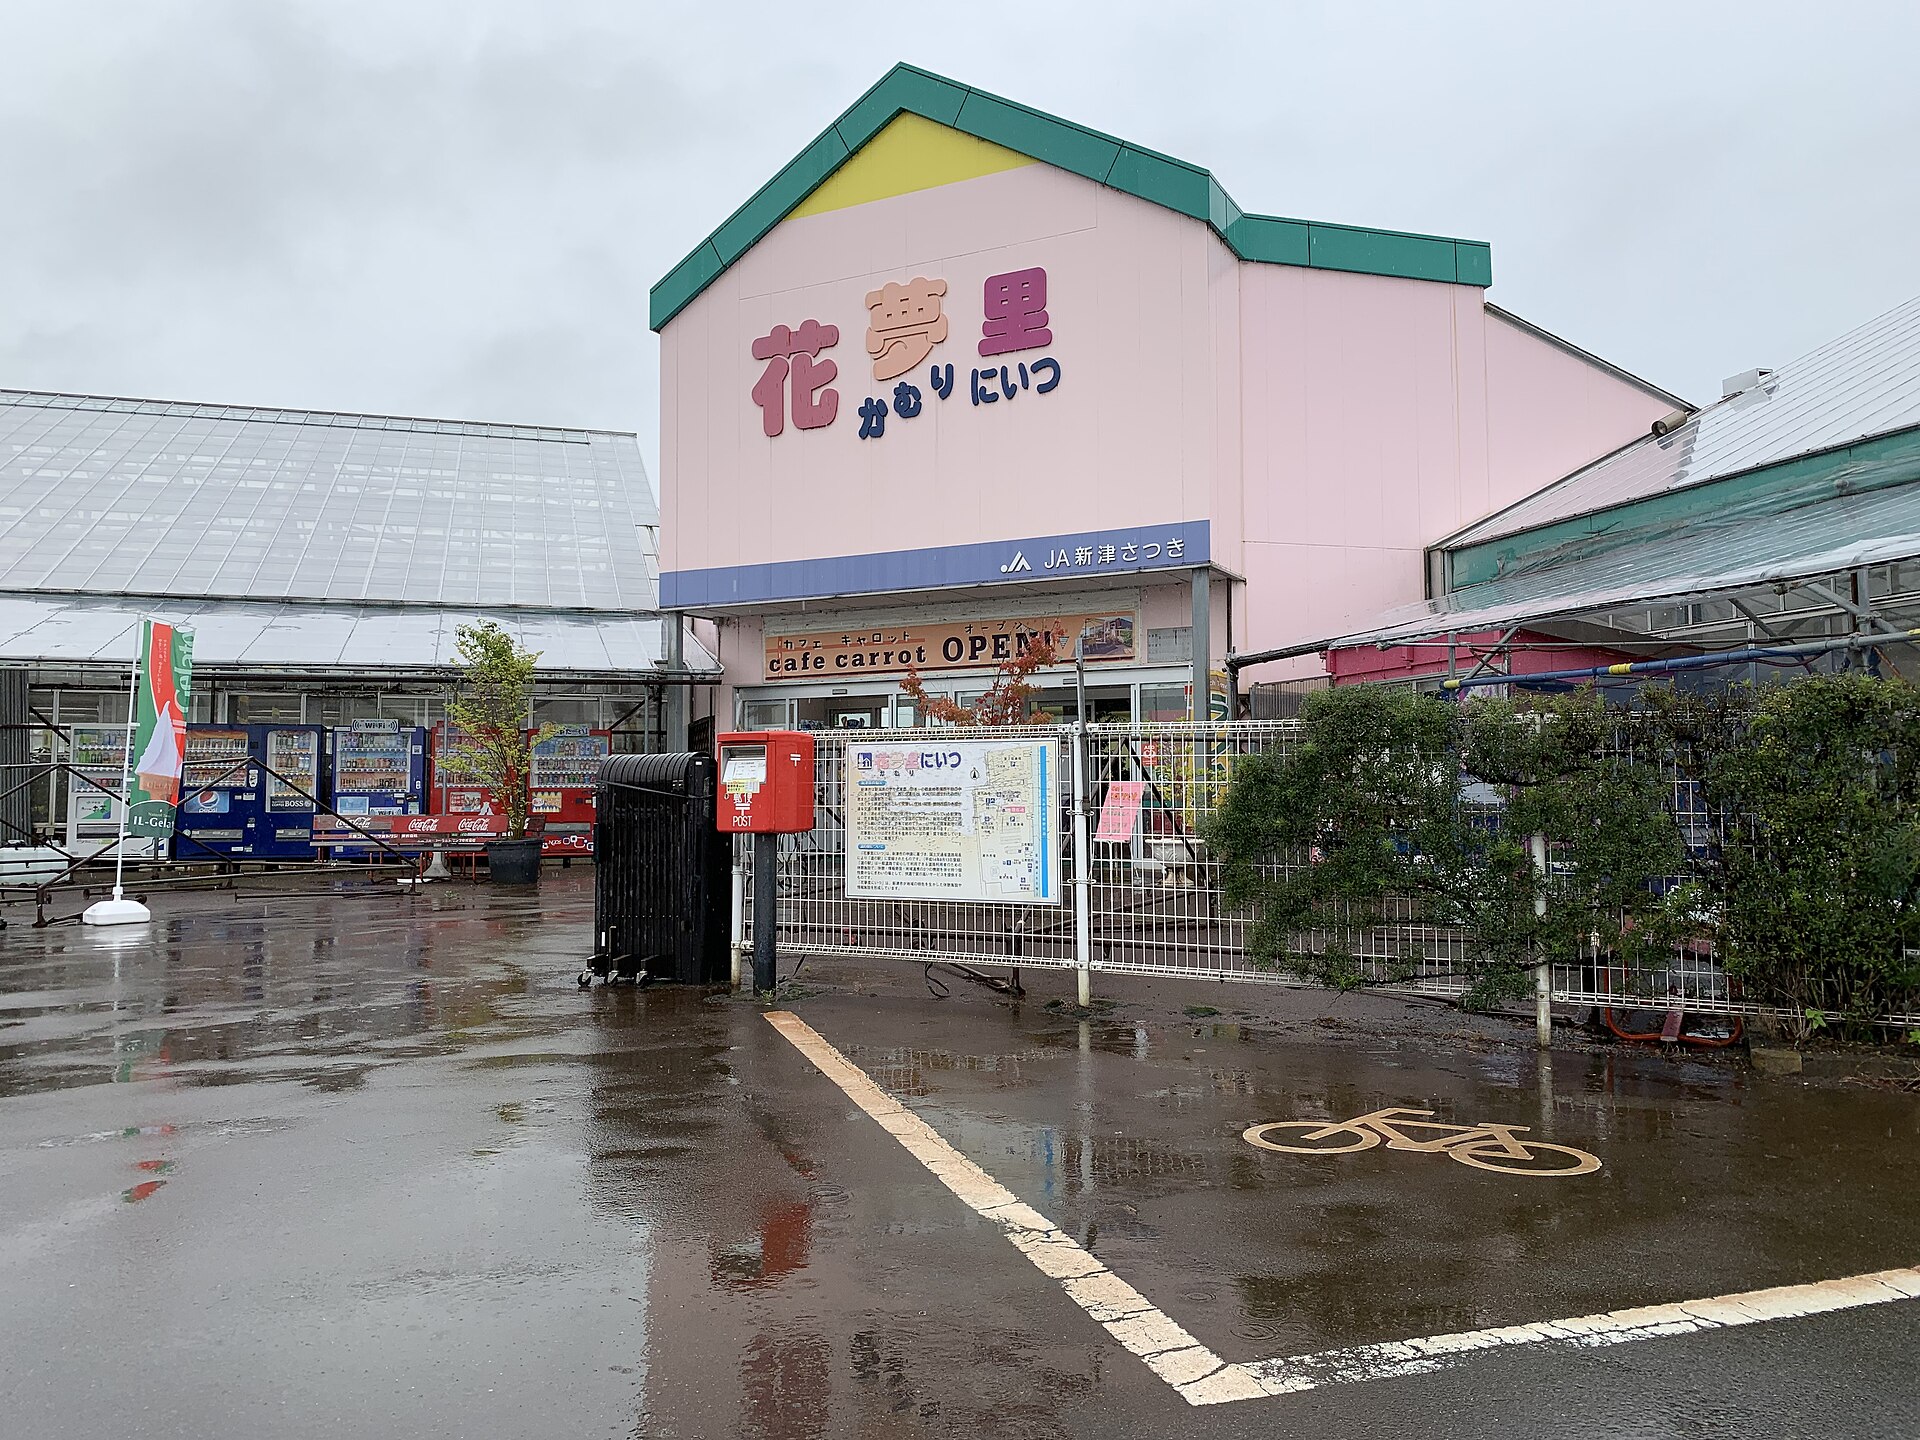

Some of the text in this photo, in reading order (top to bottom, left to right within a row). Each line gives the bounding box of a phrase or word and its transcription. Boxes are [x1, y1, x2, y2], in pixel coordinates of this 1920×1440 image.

[752, 266, 1053, 437] 花夢里
[971, 357, 1061, 406] にいつ
[1043, 537, 1186, 569] JA新津さつき
[965, 620, 1023, 634] オープン
[783, 631, 910, 649] カフェ キャロット
[769, 651, 825, 672] cafe
[835, 645, 927, 668] carrot
[365, 721, 386, 729] Wi-Fi
[732, 816, 753, 827] POST
